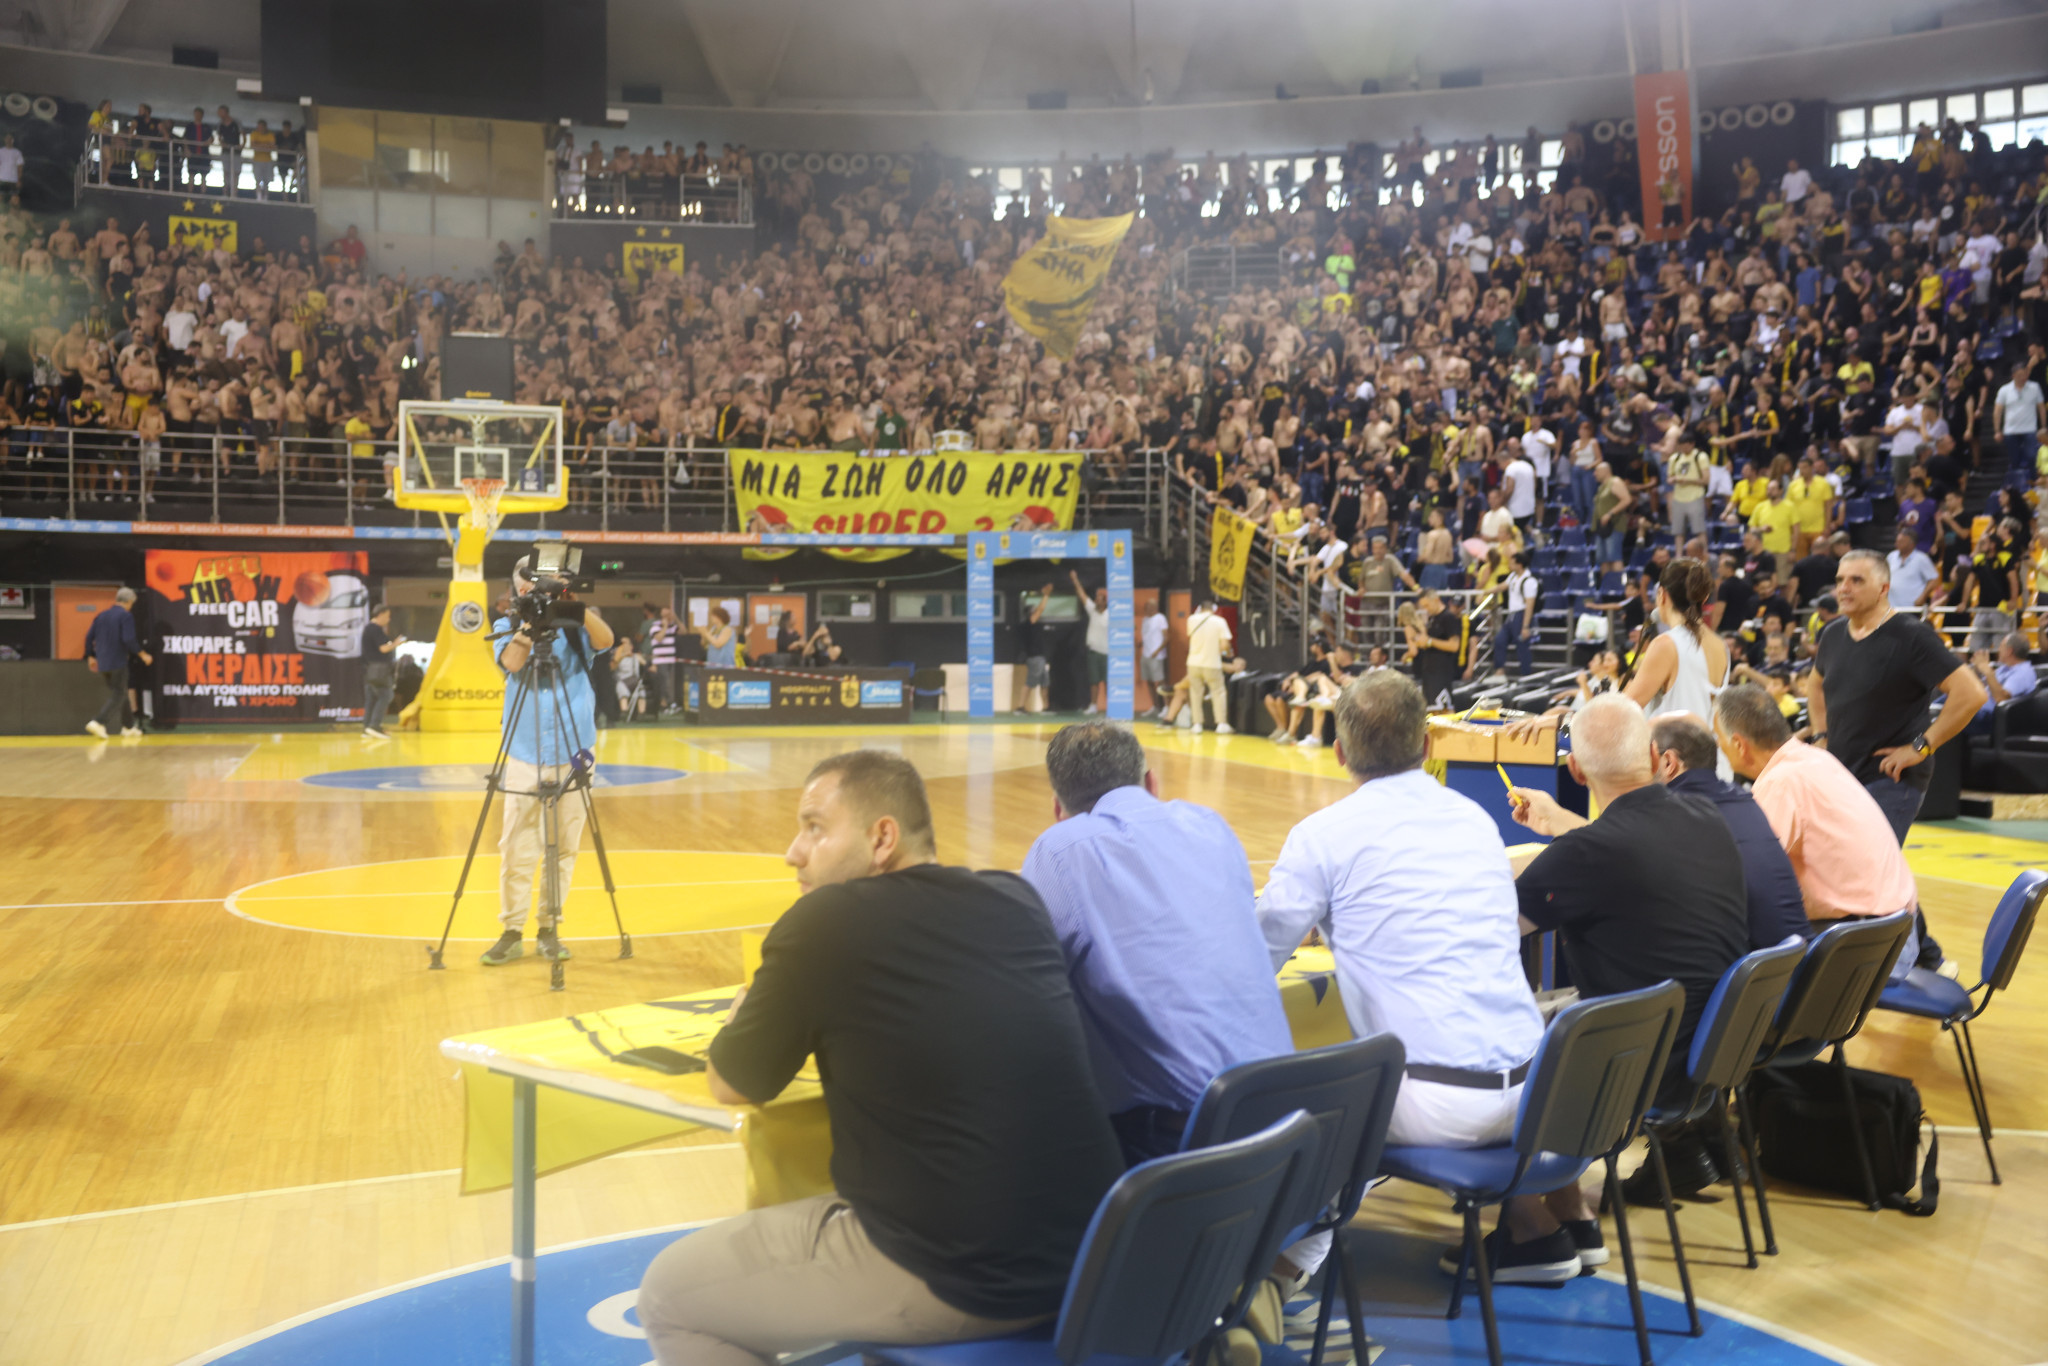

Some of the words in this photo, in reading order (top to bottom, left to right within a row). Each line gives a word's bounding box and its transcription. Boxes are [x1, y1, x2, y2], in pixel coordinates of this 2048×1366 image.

[741, 459, 800, 499] ΜΙΑ
[821, 462, 885, 497] ΖΩΗ
[905, 457, 967, 496] ΟΛΟ
[986, 462, 1075, 498] ΑΡΗΣ
[189, 602, 228, 615] FREE
[227, 600, 279, 628] CAR
[163, 636, 233, 654] ΣΚΟΡΑΡΕ
[235, 641, 246, 653] &
[186, 653, 304, 684] ΚΕΡΔΙΣΕ
[163, 685, 191, 696] ΕΝΑ
[194, 685, 280, 695] ΑΥΤΟΚΙΝΗΤΟ
[779, 685, 832, 695] HOSPITALITY
[214, 696, 237, 706] ΓΙΑ
[319, 706, 365, 718] instaca
